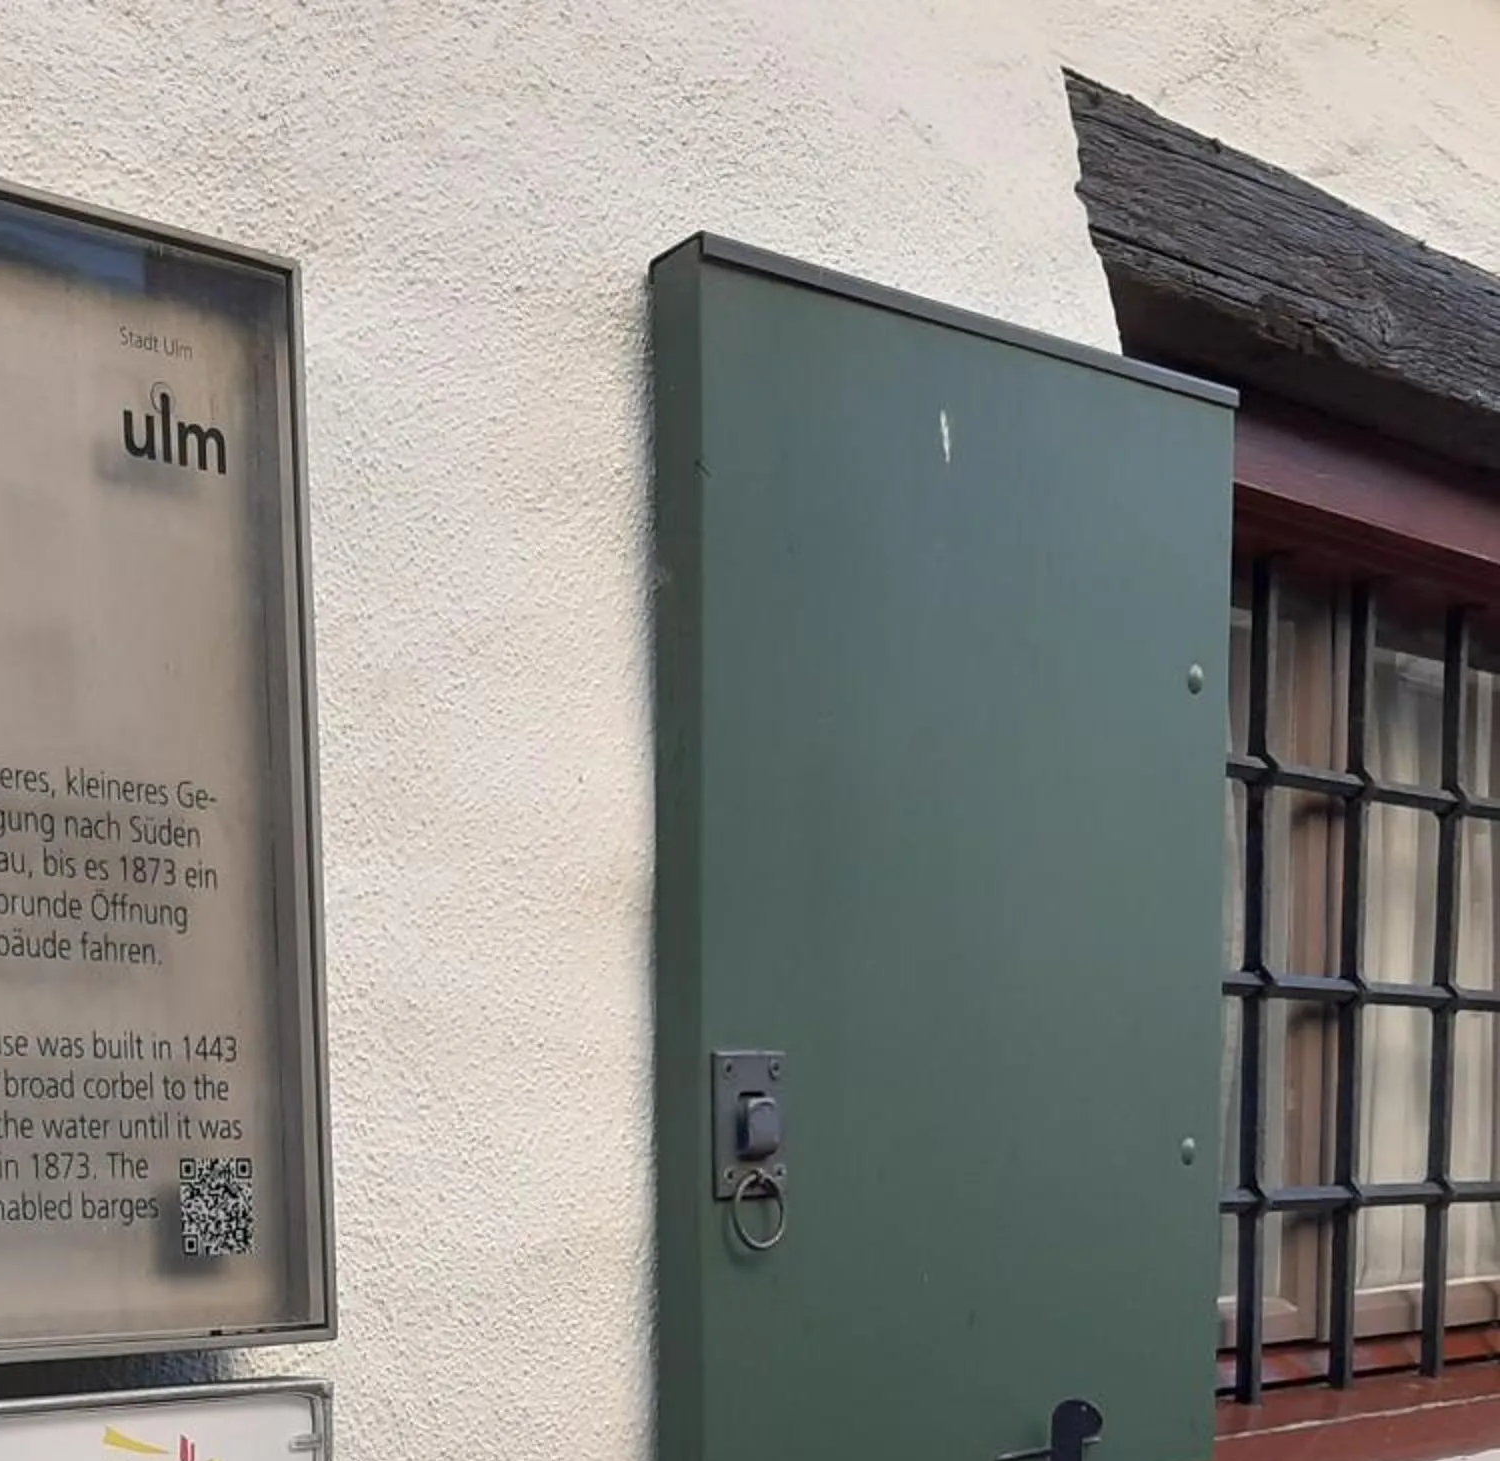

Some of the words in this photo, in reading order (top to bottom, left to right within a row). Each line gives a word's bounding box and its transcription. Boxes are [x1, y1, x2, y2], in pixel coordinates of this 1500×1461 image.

[119, 325, 158, 353] Stadt
[163, 336, 192, 360] Ulm
[124, 389, 226, 475] ulm
[66, 767, 168, 807] kleineres
[176, 781, 216, 810] Ge-
[64, 812, 120, 841] nach
[130, 815, 200, 848] Süden
[43, 847, 76, 879] bis
[84, 858, 109, 881] es
[119, 855, 175, 886] 1873
[185, 860, 218, 890] ein
[91, 889, 188, 934] Öffnung
[80, 931, 162, 964] fahren.
[37, 1037, 84, 1059] was
[93, 1031, 143, 1059] built
[153, 1035, 171, 1059] in
[184, 1035, 237, 1062] 1443
[4, 1068, 74, 1104] broad
[83, 1070, 153, 1101] corbel
[162, 1075, 185, 1101] to
[193, 1073, 228, 1101] the
[42, 1115, 110, 1139] water
[119, 1111, 169, 1140] until
[177, 1111, 192, 1140] it
[198, 1119, 243, 1140] was
[31, 1151, 96, 1180] 1873.
[106, 1151, 148, 1179] The
[81, 1191, 159, 1226] barges
